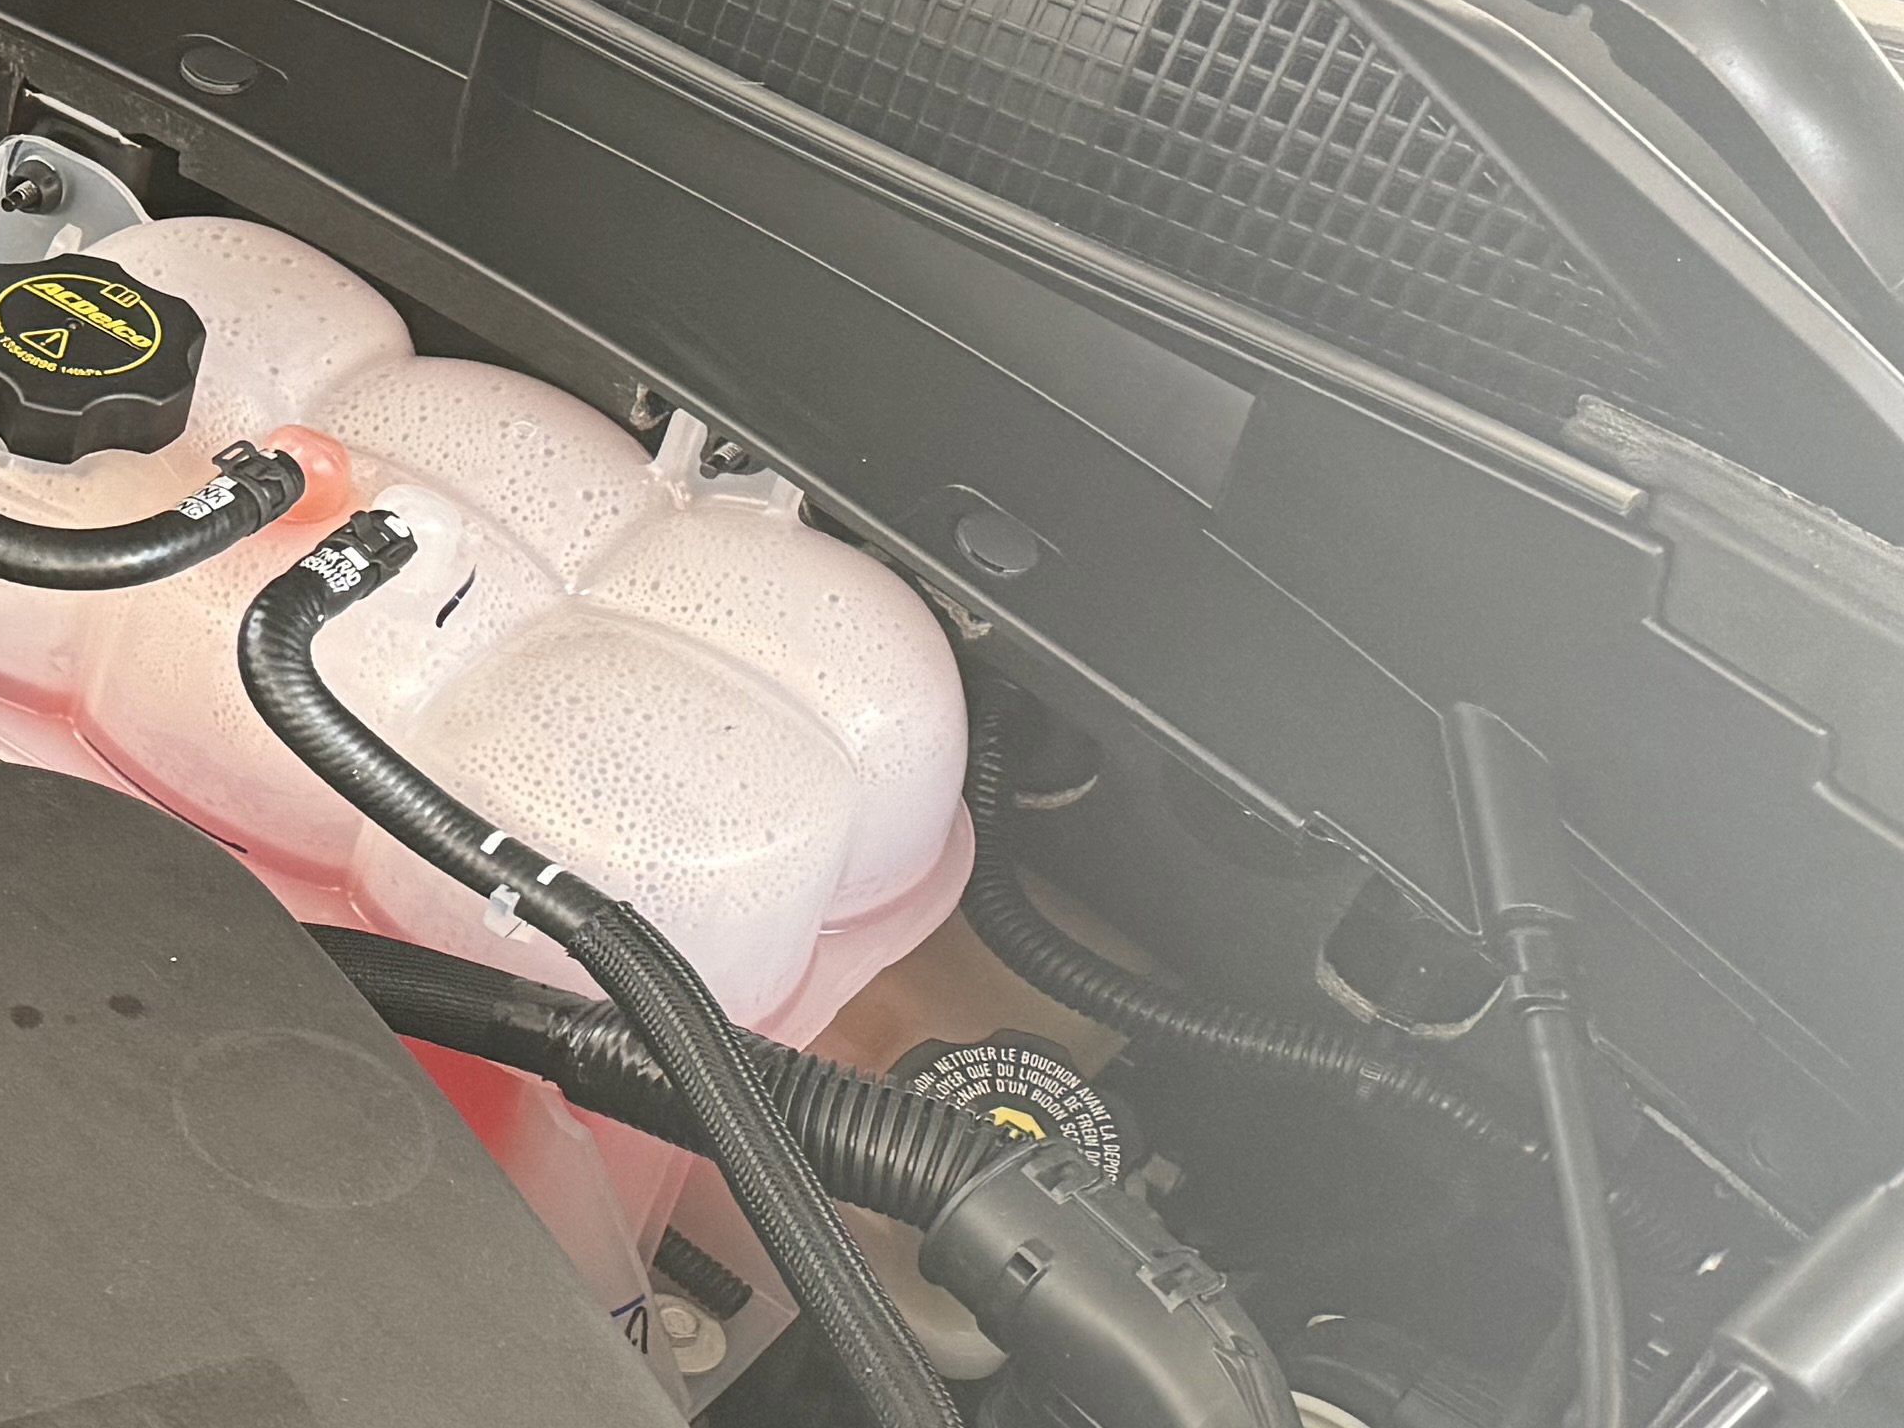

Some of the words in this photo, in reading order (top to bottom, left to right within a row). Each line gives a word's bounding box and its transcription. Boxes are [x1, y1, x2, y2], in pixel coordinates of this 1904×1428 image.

[32, 282, 152, 348] ACDelco
[935, 1046, 997, 1072] NETTOYER
[1001, 1048, 1016, 1062] LE
[1021, 1050, 1080, 1088] BOUCHON
[1075, 1086, 1111, 1124] AVANT
[1100, 1123, 1118, 1141] LA
[968, 1064, 992, 1079] QUE
[997, 1062, 1014, 1077] DU
[1018, 1067, 1069, 1099] LIQUIDE
[1063, 1096, 1079, 1113] DE
[1075, 1112, 1100, 1149] FREIN
[996, 1078, 1028, 1095] D'UN
[1030, 1088, 1068, 1122] BIDON
